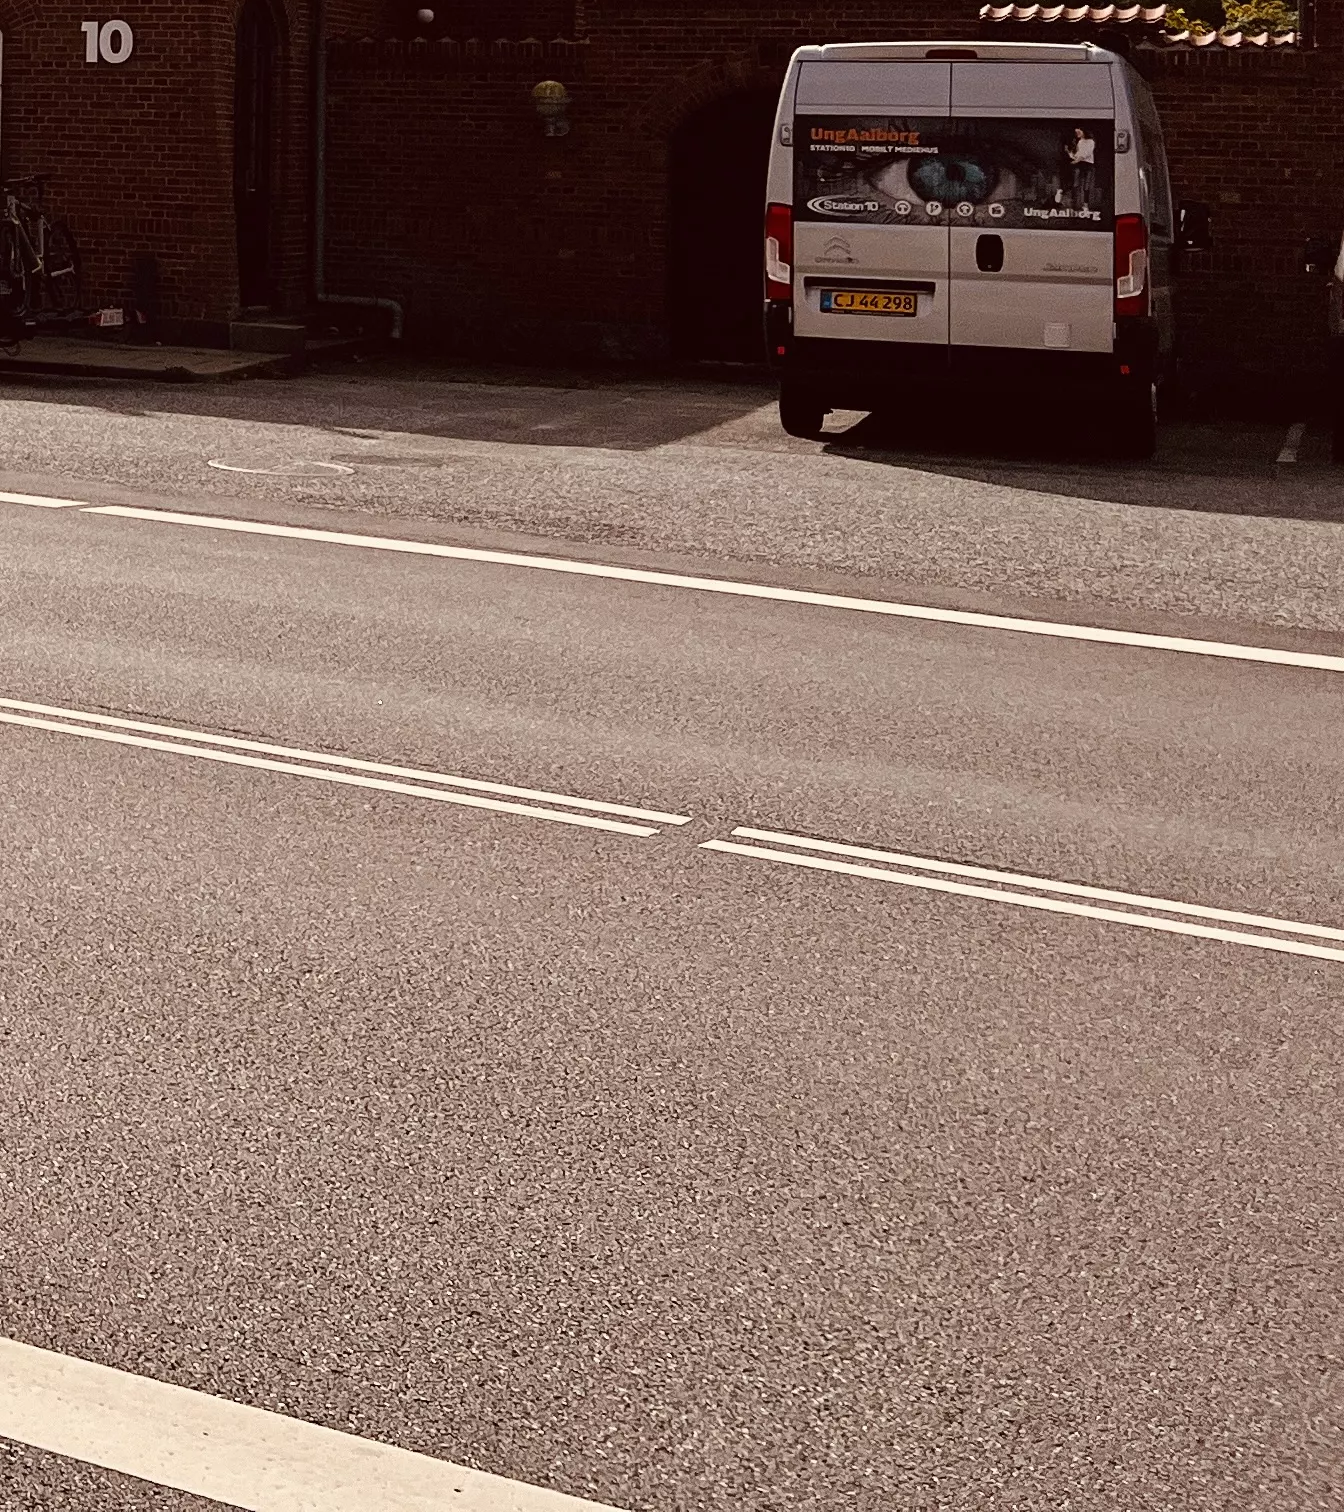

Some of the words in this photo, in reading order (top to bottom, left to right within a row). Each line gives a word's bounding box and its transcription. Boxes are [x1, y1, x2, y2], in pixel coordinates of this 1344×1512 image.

[81, 19, 133, 64] 10
[811, 128, 920, 145] UngAalborg
[823, 200, 864, 211] Station
[863, 201, 879, 211] 10
[1024, 207, 1101, 220] UngAalborg
[833, 293, 855, 308] CJ
[859, 295, 879, 309] 44
[882, 296, 913, 310] 298
